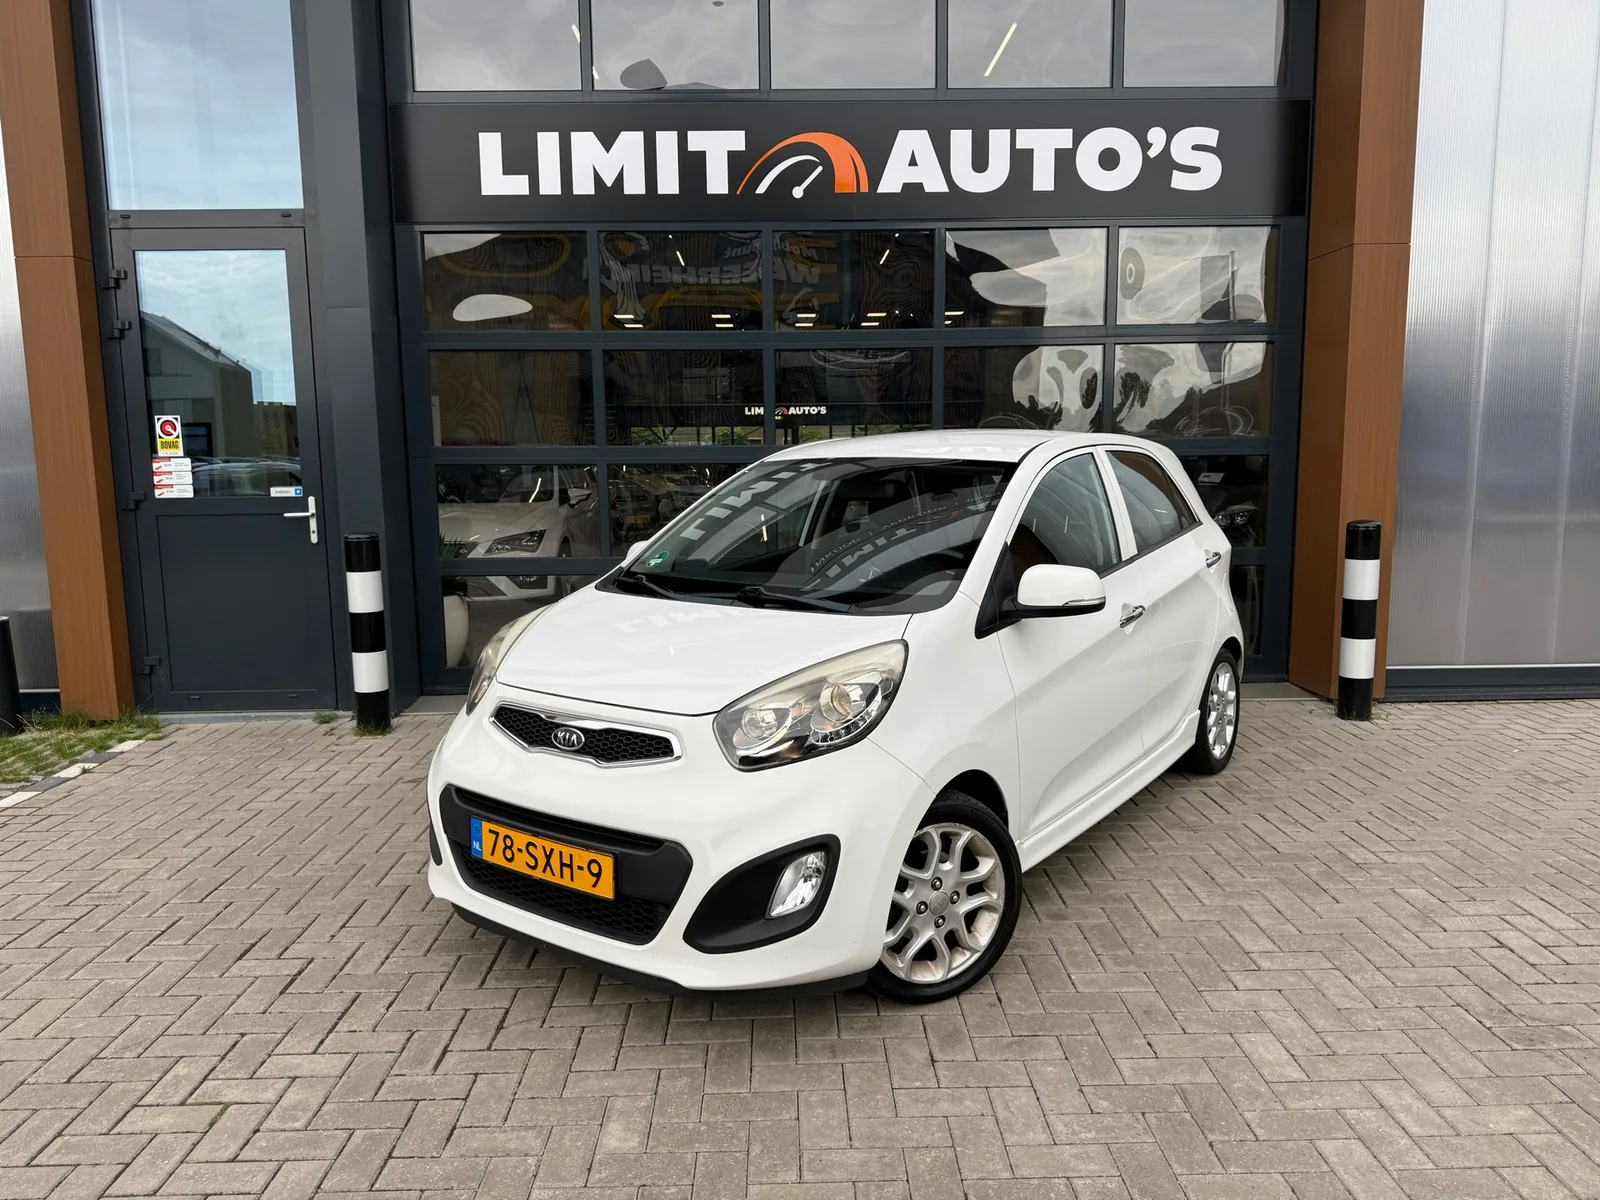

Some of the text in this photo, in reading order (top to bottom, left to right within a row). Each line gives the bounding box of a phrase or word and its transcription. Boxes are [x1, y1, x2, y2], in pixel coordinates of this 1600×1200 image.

[478, 126, 1222, 195] LIMIT AUTO'S
[788, 406, 827, 415] AUTO'S
[160, 440, 180, 450] BOVAG
[556, 731, 578, 747] KIA
[473, 840, 482, 851] NL
[488, 828, 603, 888] 78-SXH-9
